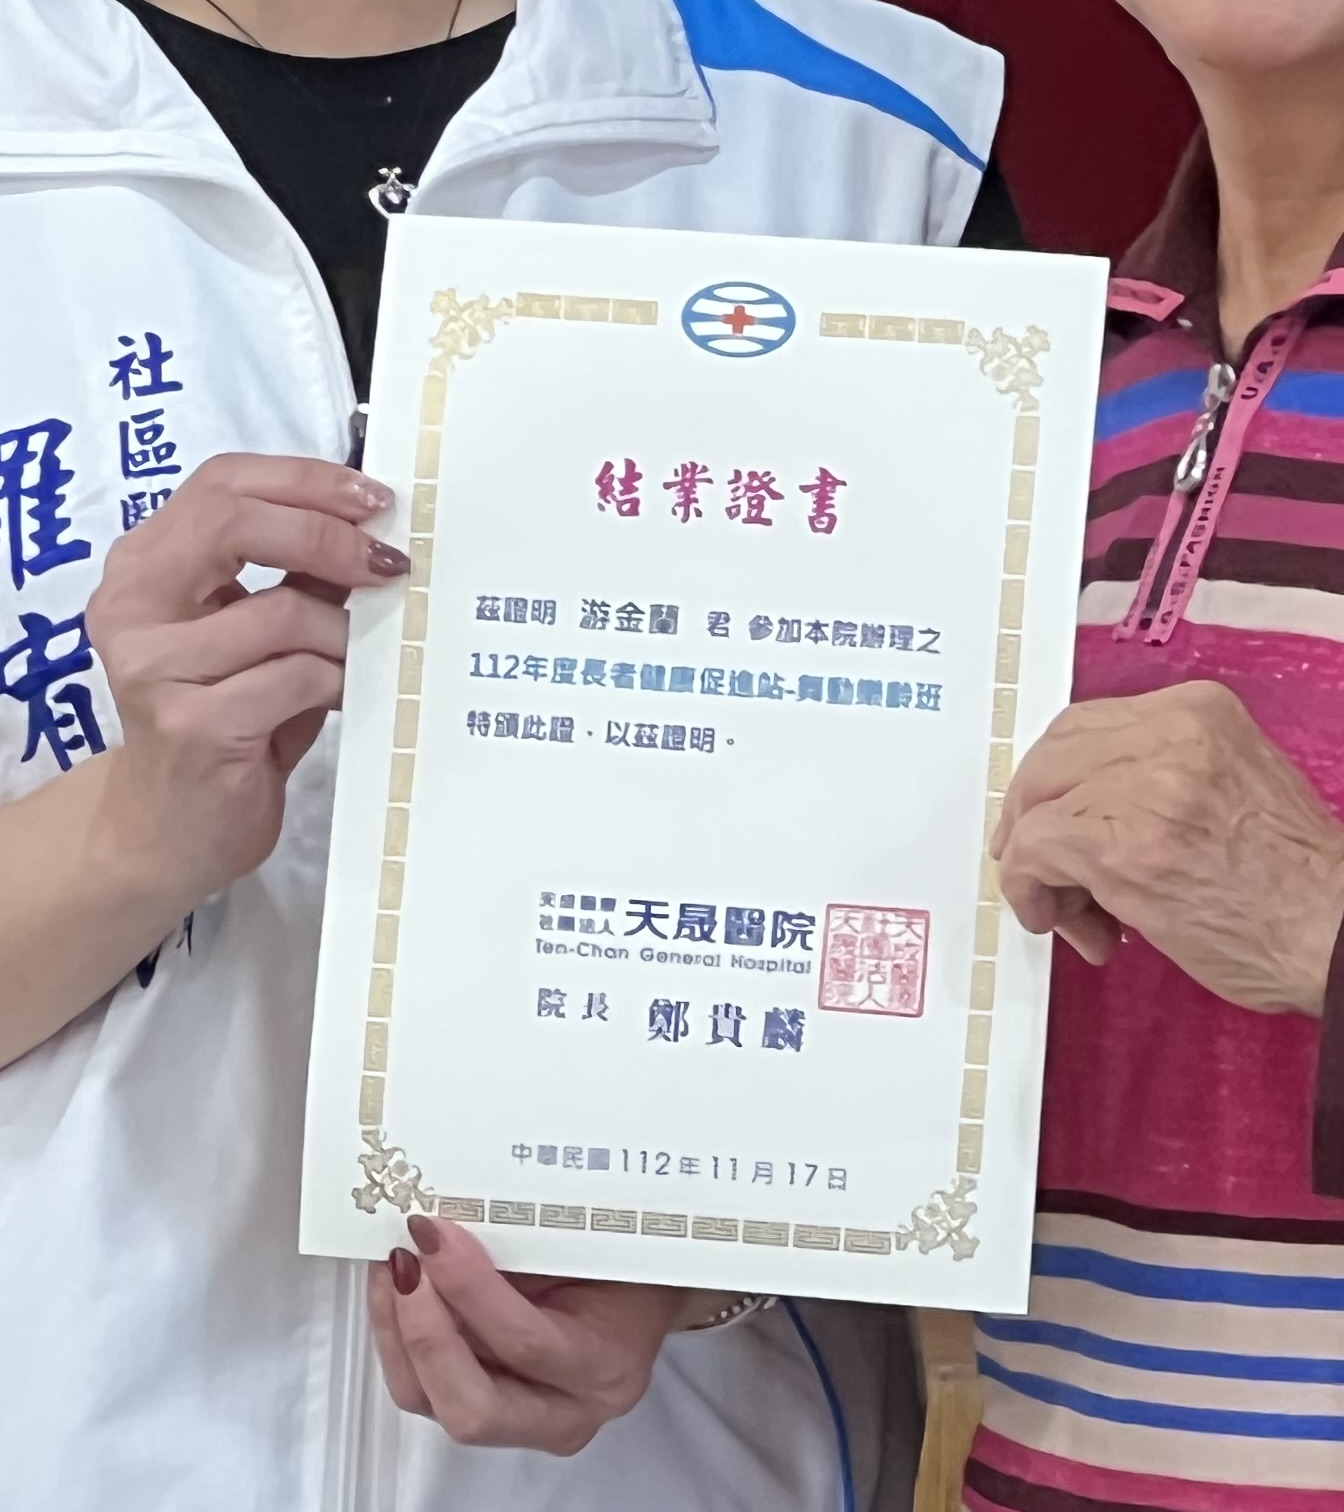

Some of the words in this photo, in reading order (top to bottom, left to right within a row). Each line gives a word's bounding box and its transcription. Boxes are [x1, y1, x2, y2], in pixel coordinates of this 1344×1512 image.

[594, 457, 848, 535] 結業證書
[706, 610, 732, 639] 君
